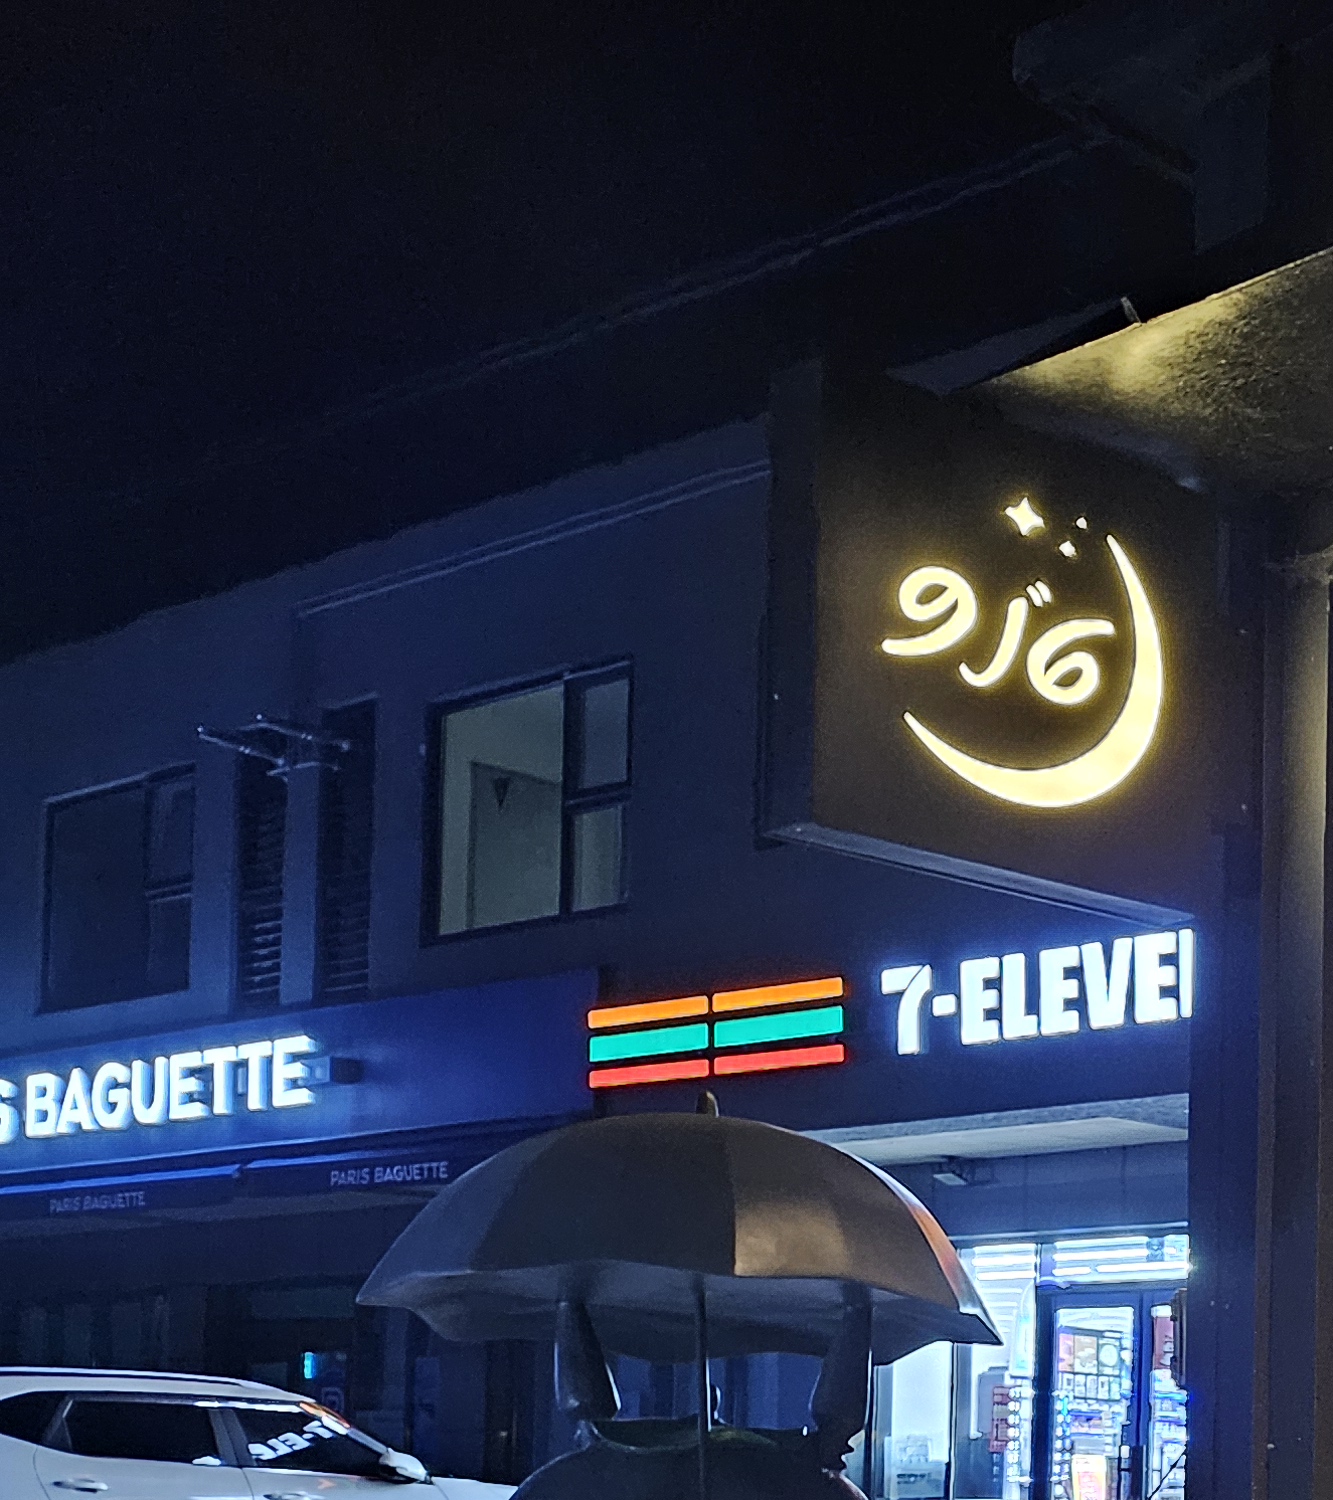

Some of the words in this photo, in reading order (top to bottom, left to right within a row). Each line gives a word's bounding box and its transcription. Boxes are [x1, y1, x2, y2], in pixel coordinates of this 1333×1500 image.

[25, 1034, 317, 1138] BAGUETTE
[330, 1167, 370, 1186] PARIS
[374, 1160, 449, 1183] BAGUETTE
[49, 1196, 81, 1213] PARIS
[82, 1191, 145, 1211] BAGUETTE
